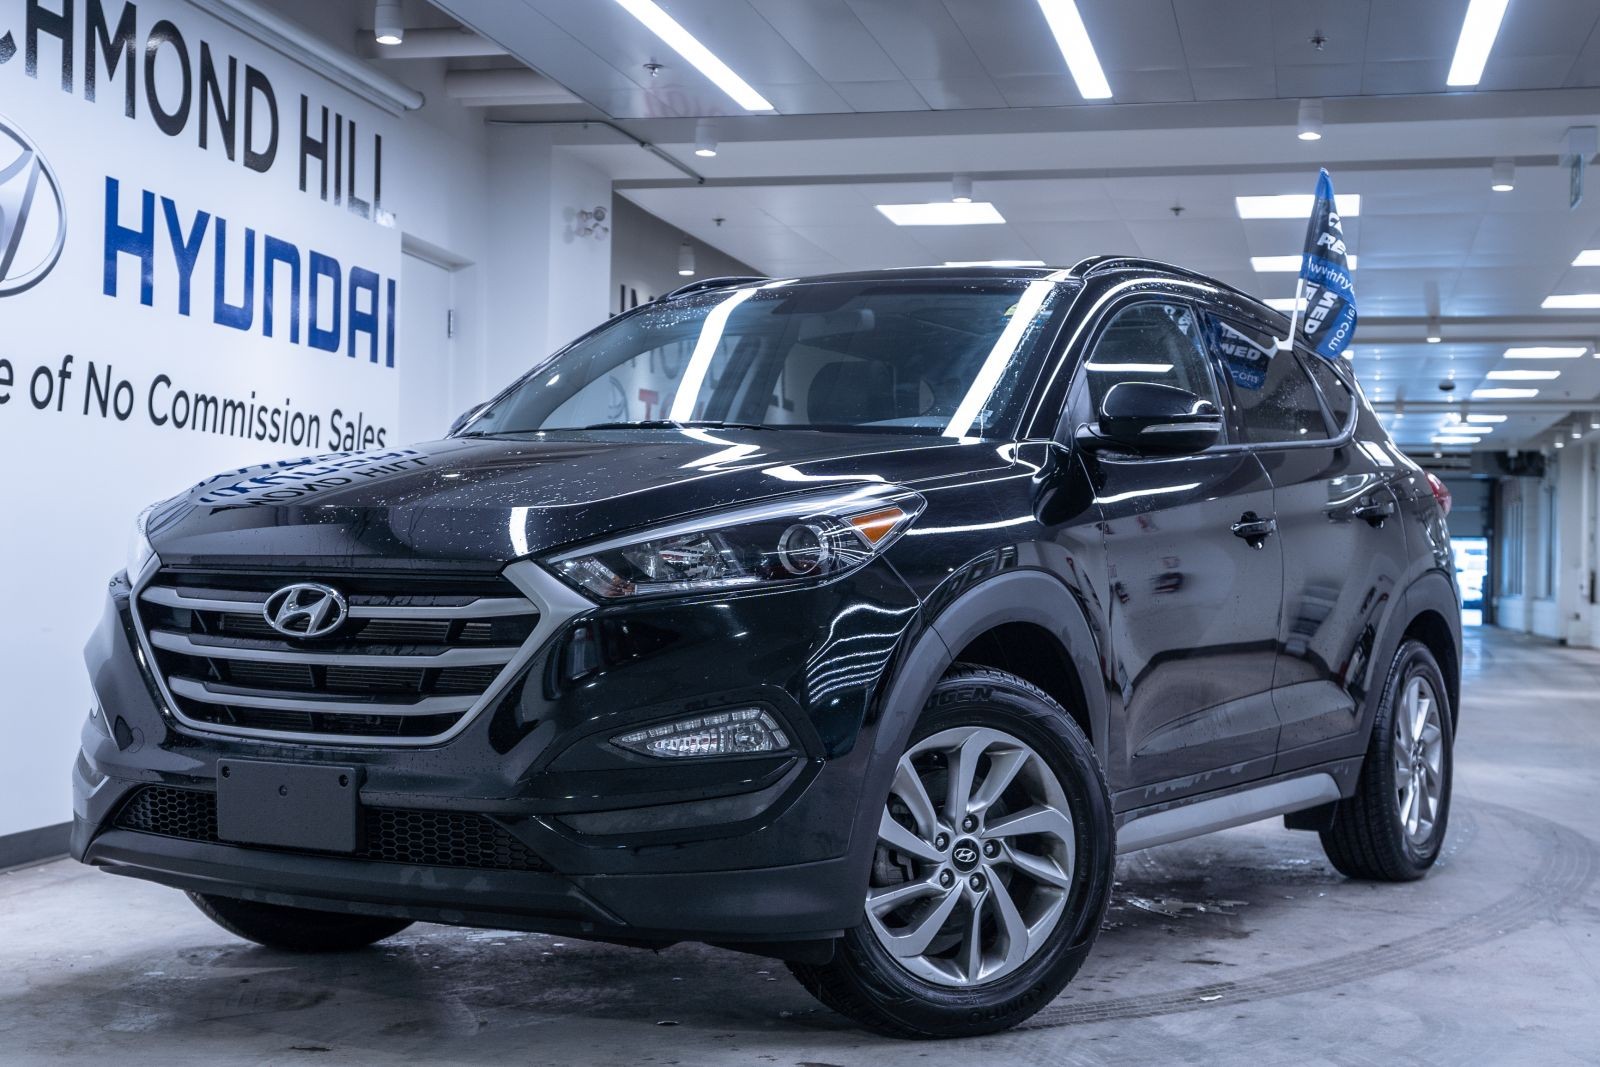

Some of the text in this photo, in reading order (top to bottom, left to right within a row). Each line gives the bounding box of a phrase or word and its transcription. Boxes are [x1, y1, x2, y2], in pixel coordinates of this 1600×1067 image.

[0, 0, 396, 229] HMOND HILL
[103, 175, 396, 369] HYUNDAI
[29, 354, 74, 411] of
[83, 361, 134, 421] No
[148, 373, 320, 449] Commission
[328, 408, 387, 452] Sales
